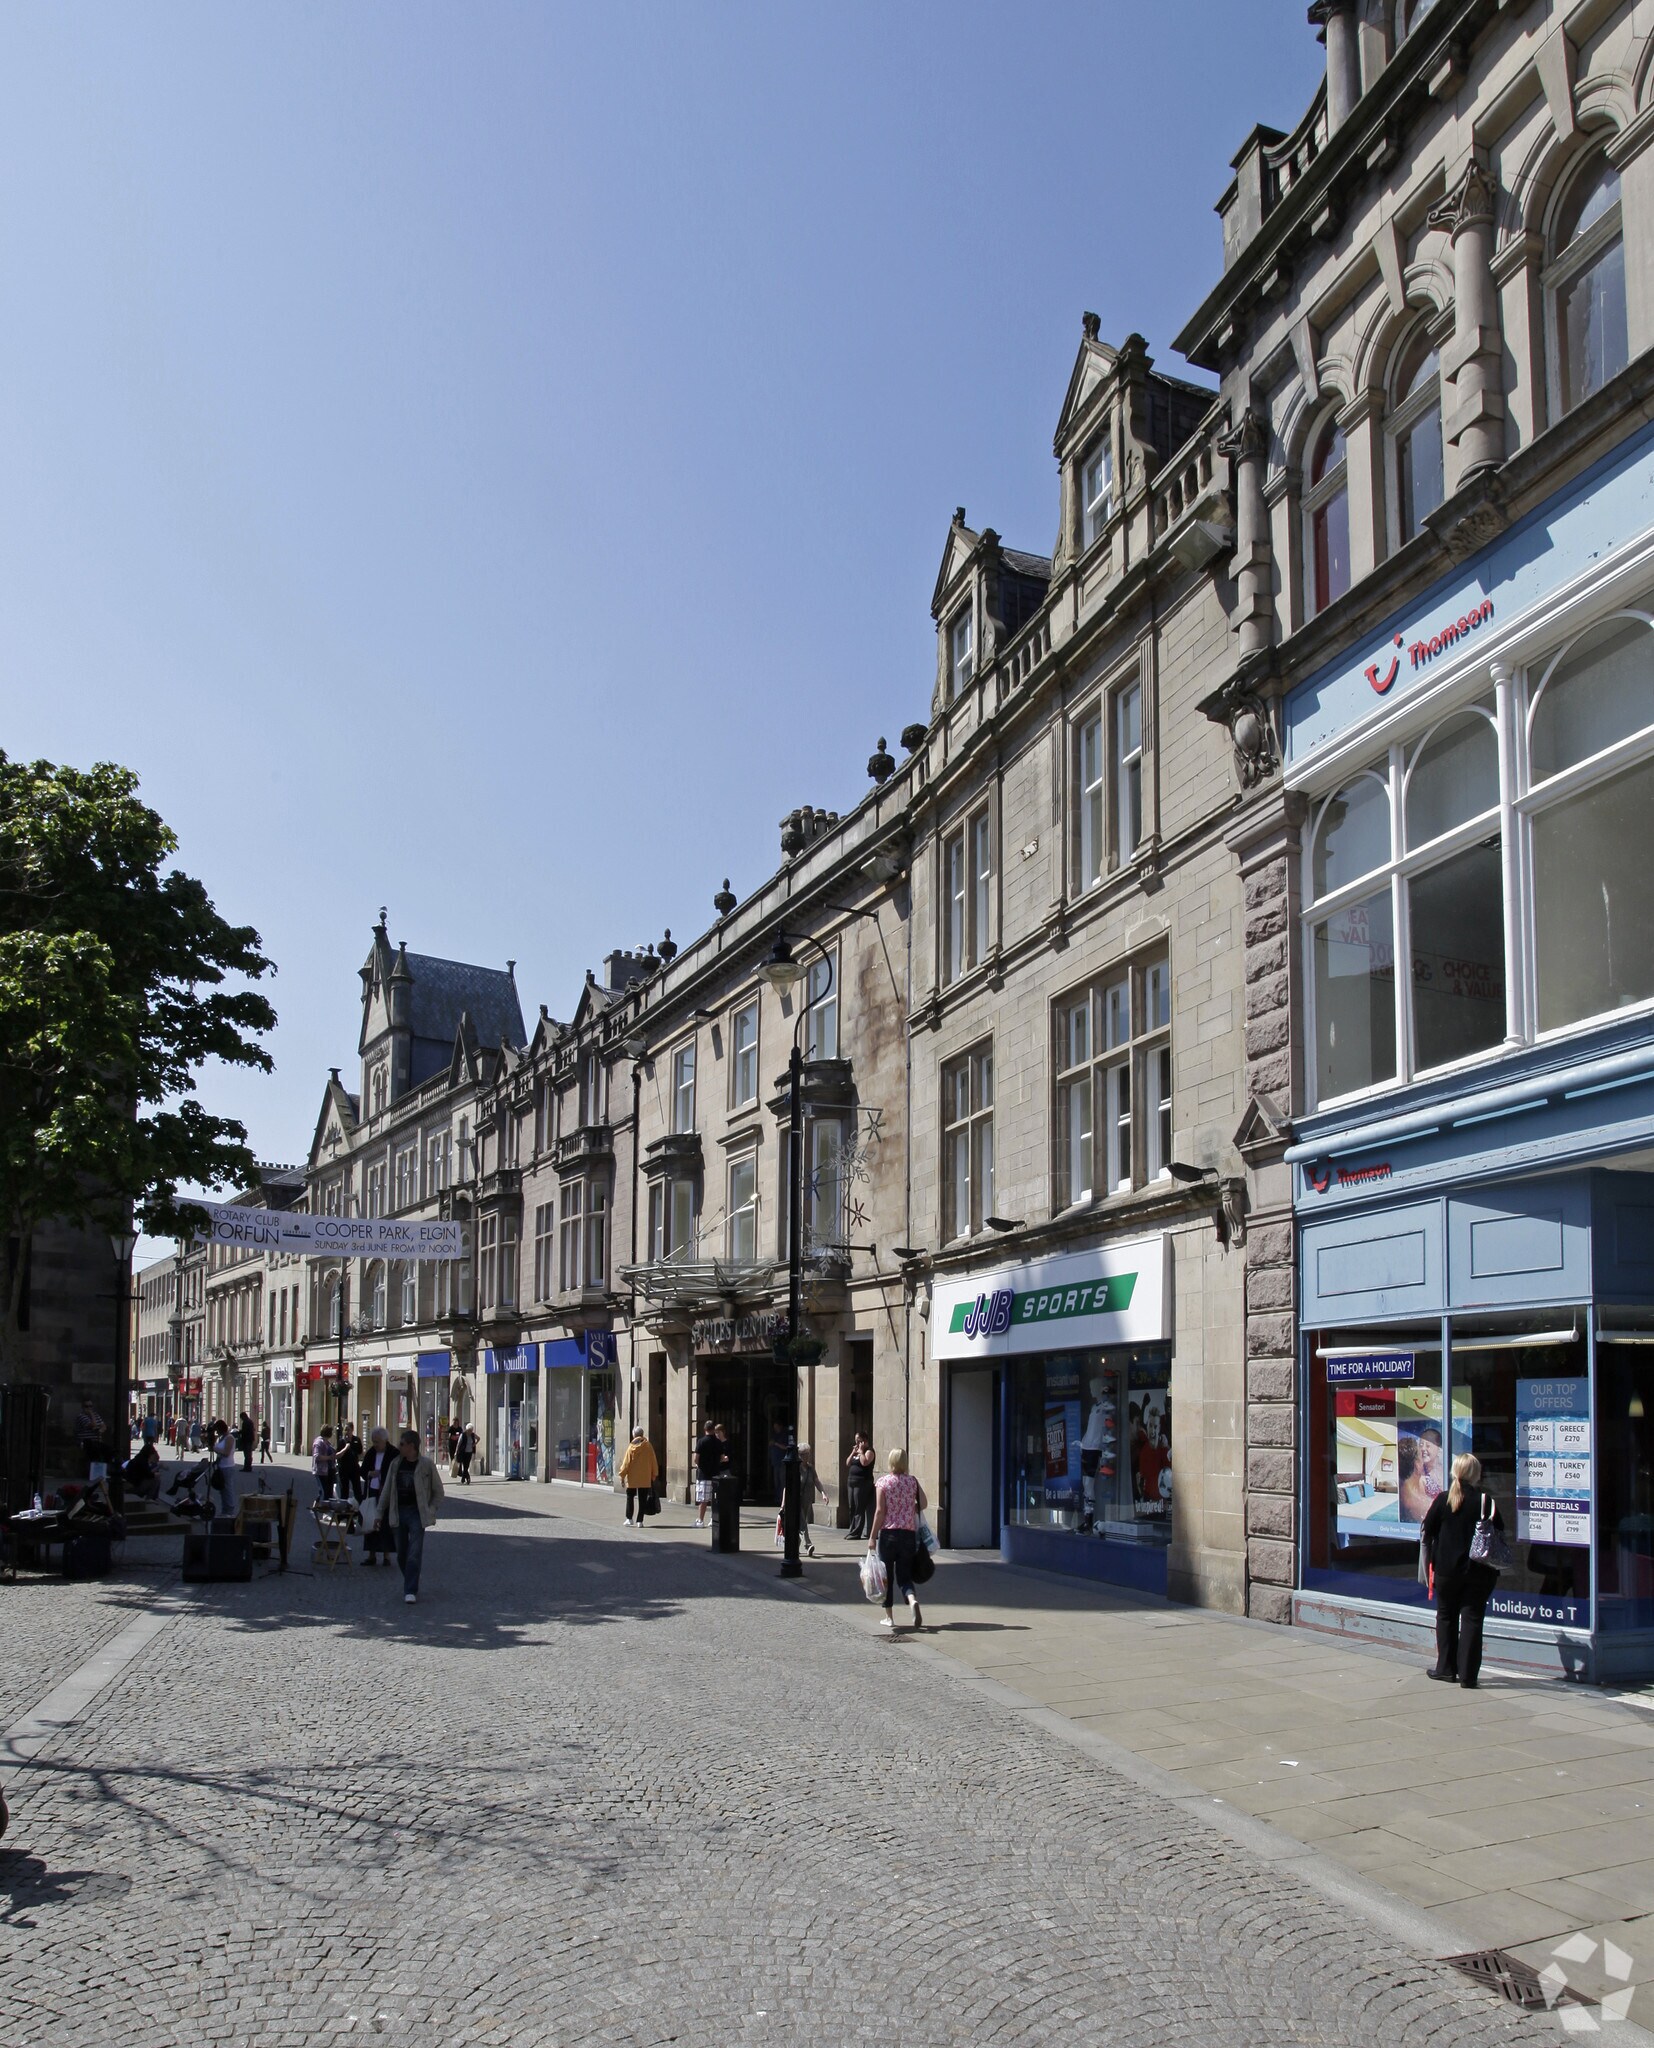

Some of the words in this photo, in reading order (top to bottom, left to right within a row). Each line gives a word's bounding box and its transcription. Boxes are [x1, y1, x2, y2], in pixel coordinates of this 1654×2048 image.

[1407, 598, 1493, 668] Thomson
[1443, 959, 1490, 981] CHOICE
[1453, 979, 1463, 996] &
[1337, 1162, 1392, 1186] Thomson
[213, 1209, 252, 1223] ROTARY
[255, 1214, 280, 1227] CLUB
[315, 1221, 373, 1239] COOPER
[379, 1225, 414, 1242] PARK,
[420, 1226, 456, 1241] ELGIN
[314, 1240, 348, 1250] SUNDAY
[351, 1242, 366, 1252] 3rd
[366, 1243, 388, 1253] JUNE
[390, 1243, 415, 1253] FROM
[418, 1244, 426, 1253] 12
[428, 1244, 457, 1254] NOON
[963, 1288, 1014, 1337] JJB
[1022, 1285, 1109, 1318] SPORTS
[590, 1340, 606, 1368] S
[1329, 1363, 1347, 1375] TIME
[1348, 1362, 1364, 1374] FOR
[1365, 1362, 1371, 1373] A
[1372, 1360, 1411, 1373] HOLIDAY?
[1530, 1384, 1553, 1396] OUR
[1555, 1383, 1577, 1395] TOP
[1359, 1403, 1386, 1411] Sensatori
[1534, 1397, 1574, 1408] OFFERS
[1046, 1428, 1065, 1444] FOOTY
[1522, 1424, 1549, 1432] CYPRUS
[1528, 1434, 1544, 1442] £245
[1529, 1500, 1556, 1510] CRUISE
[1556, 1502, 1580, 1511] DEALS
[1492, 1598, 1536, 1619] holiday
[1539, 1605, 1553, 1618] to
[1556, 1609, 1564, 1620] a
[1567, 1606, 1577, 1621] T
